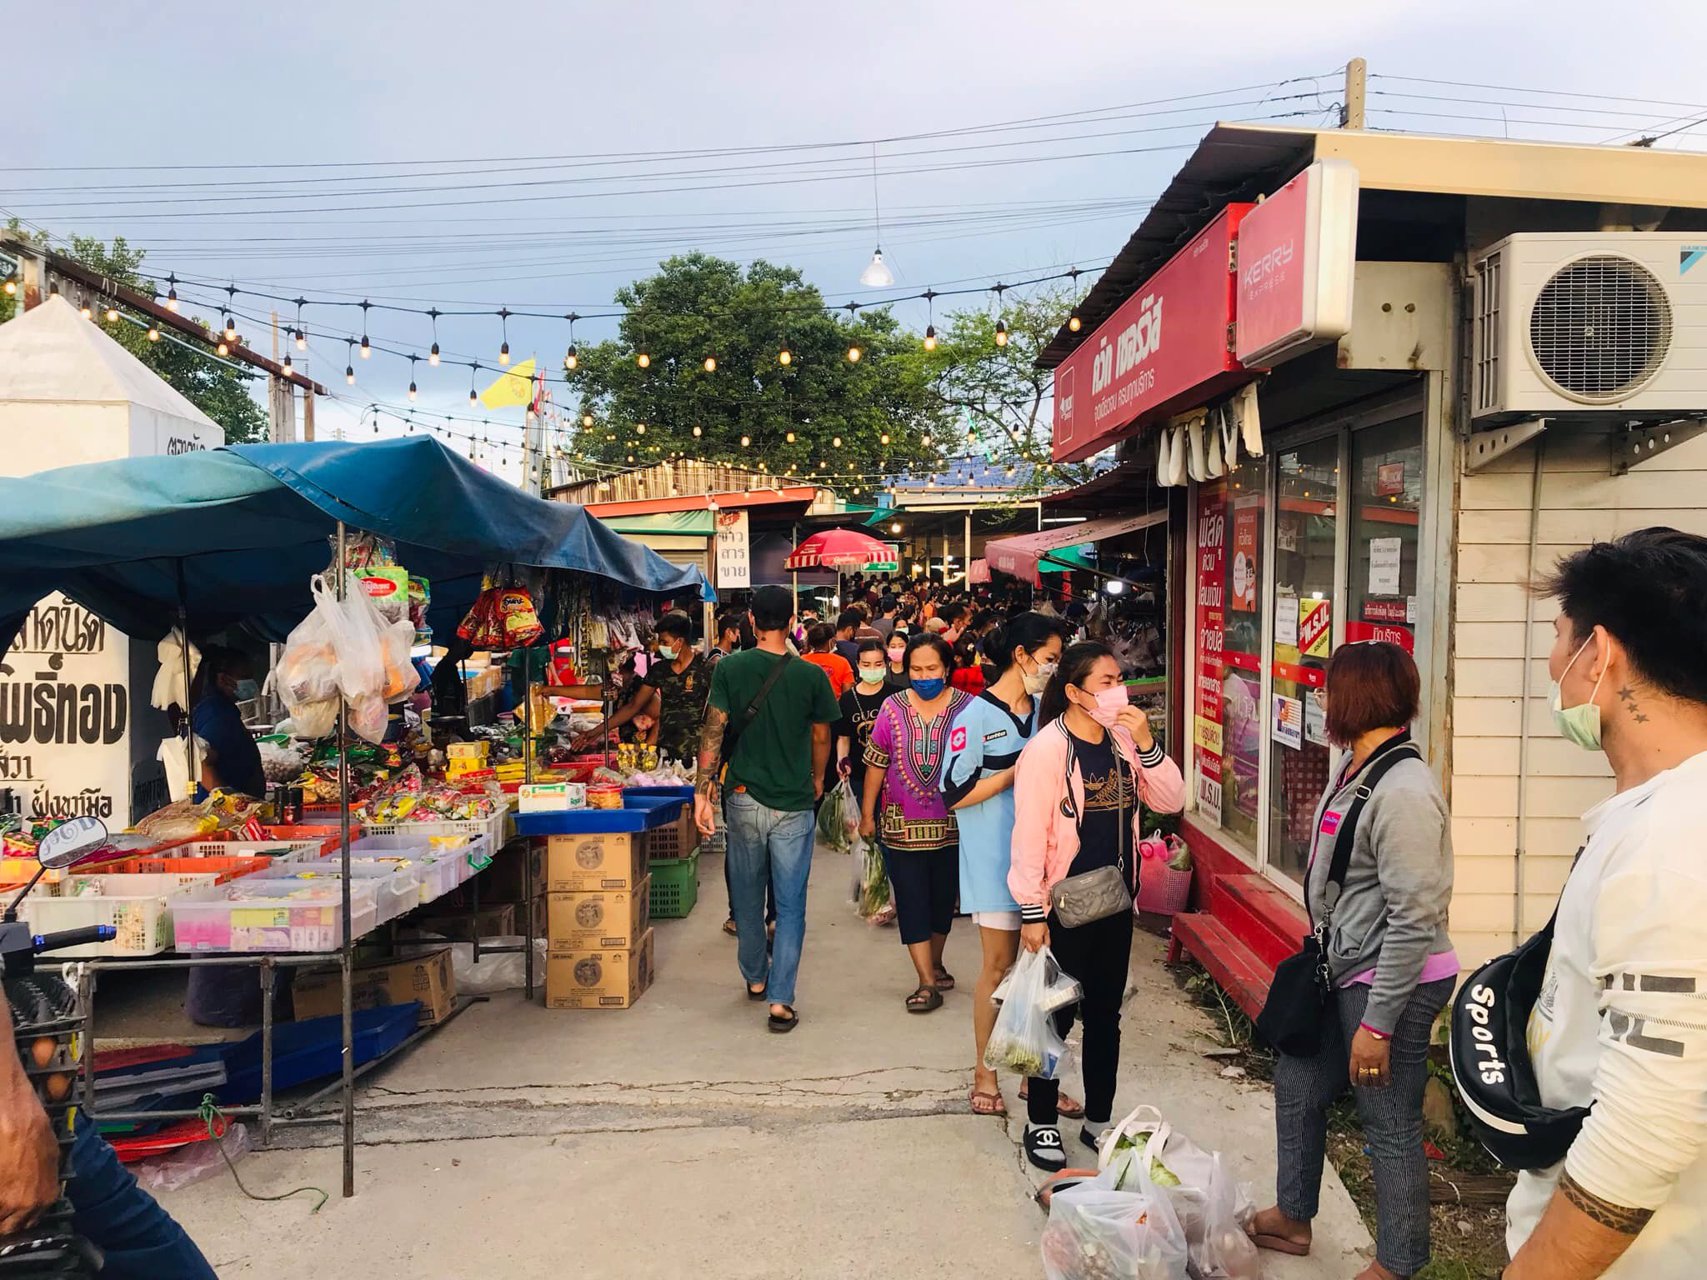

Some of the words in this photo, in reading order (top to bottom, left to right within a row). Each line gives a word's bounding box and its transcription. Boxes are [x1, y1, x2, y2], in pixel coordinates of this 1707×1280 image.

[1244, 239, 1294, 290] KERRY
[1092, 335, 1113, 397] ควิก
[1116, 293, 1163, 380] เซอร์วิส
[722, 548, 745, 559] สาร
[721, 566, 746, 577] ขาย
[986, 731, 1006, 742] lotto
[1464, 984, 1506, 1085] Sports
